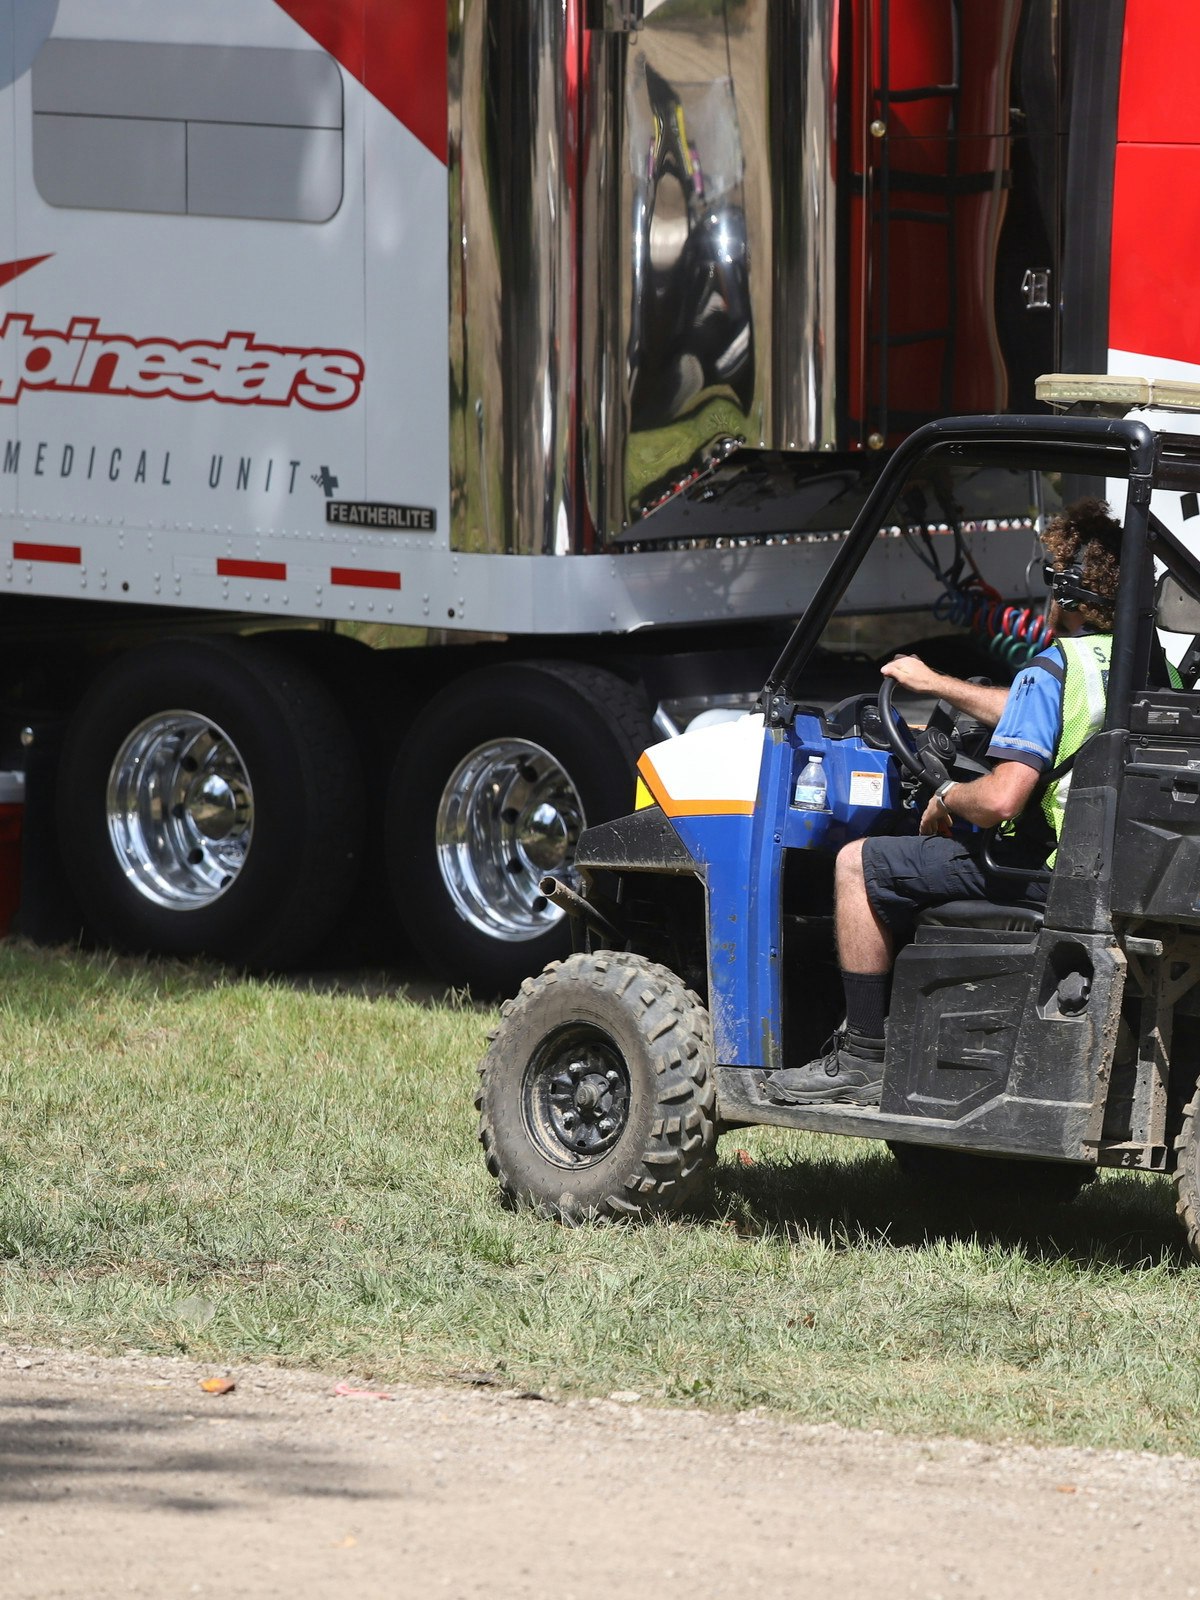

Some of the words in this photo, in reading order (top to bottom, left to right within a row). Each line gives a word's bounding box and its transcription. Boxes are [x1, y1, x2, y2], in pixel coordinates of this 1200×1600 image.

[0, 312, 365, 411] lpinestars
[3, 440, 172, 486] MEDICAL
[208, 454, 301, 494] UNIT
[329, 503, 431, 529] FEATHERLITE
